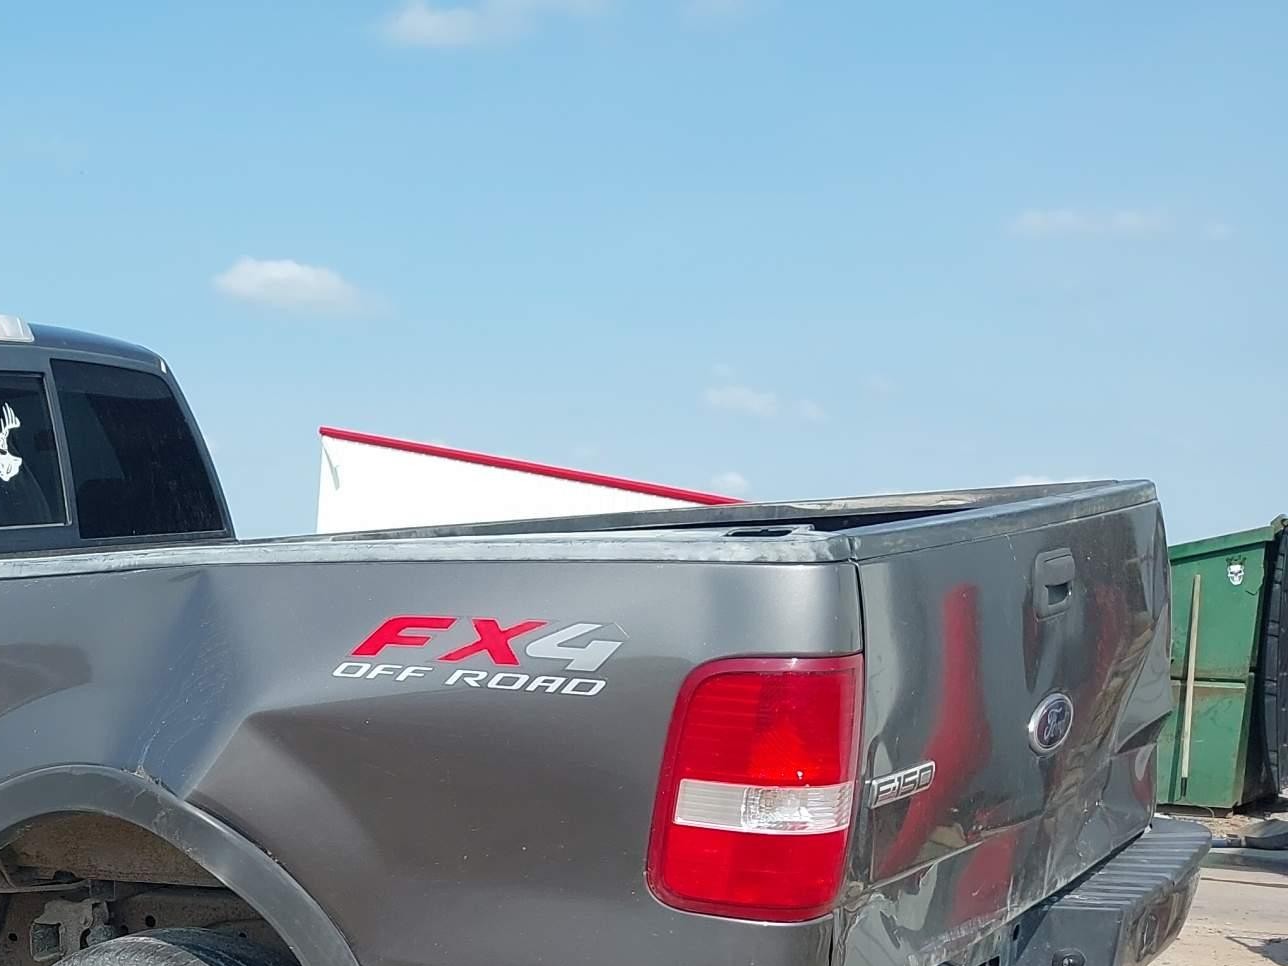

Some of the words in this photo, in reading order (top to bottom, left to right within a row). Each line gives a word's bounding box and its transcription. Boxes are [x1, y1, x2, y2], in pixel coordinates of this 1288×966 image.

[349, 615, 625, 673] FX4
[332, 661, 434, 683] OFF
[445, 669, 607, 697] ROAD
